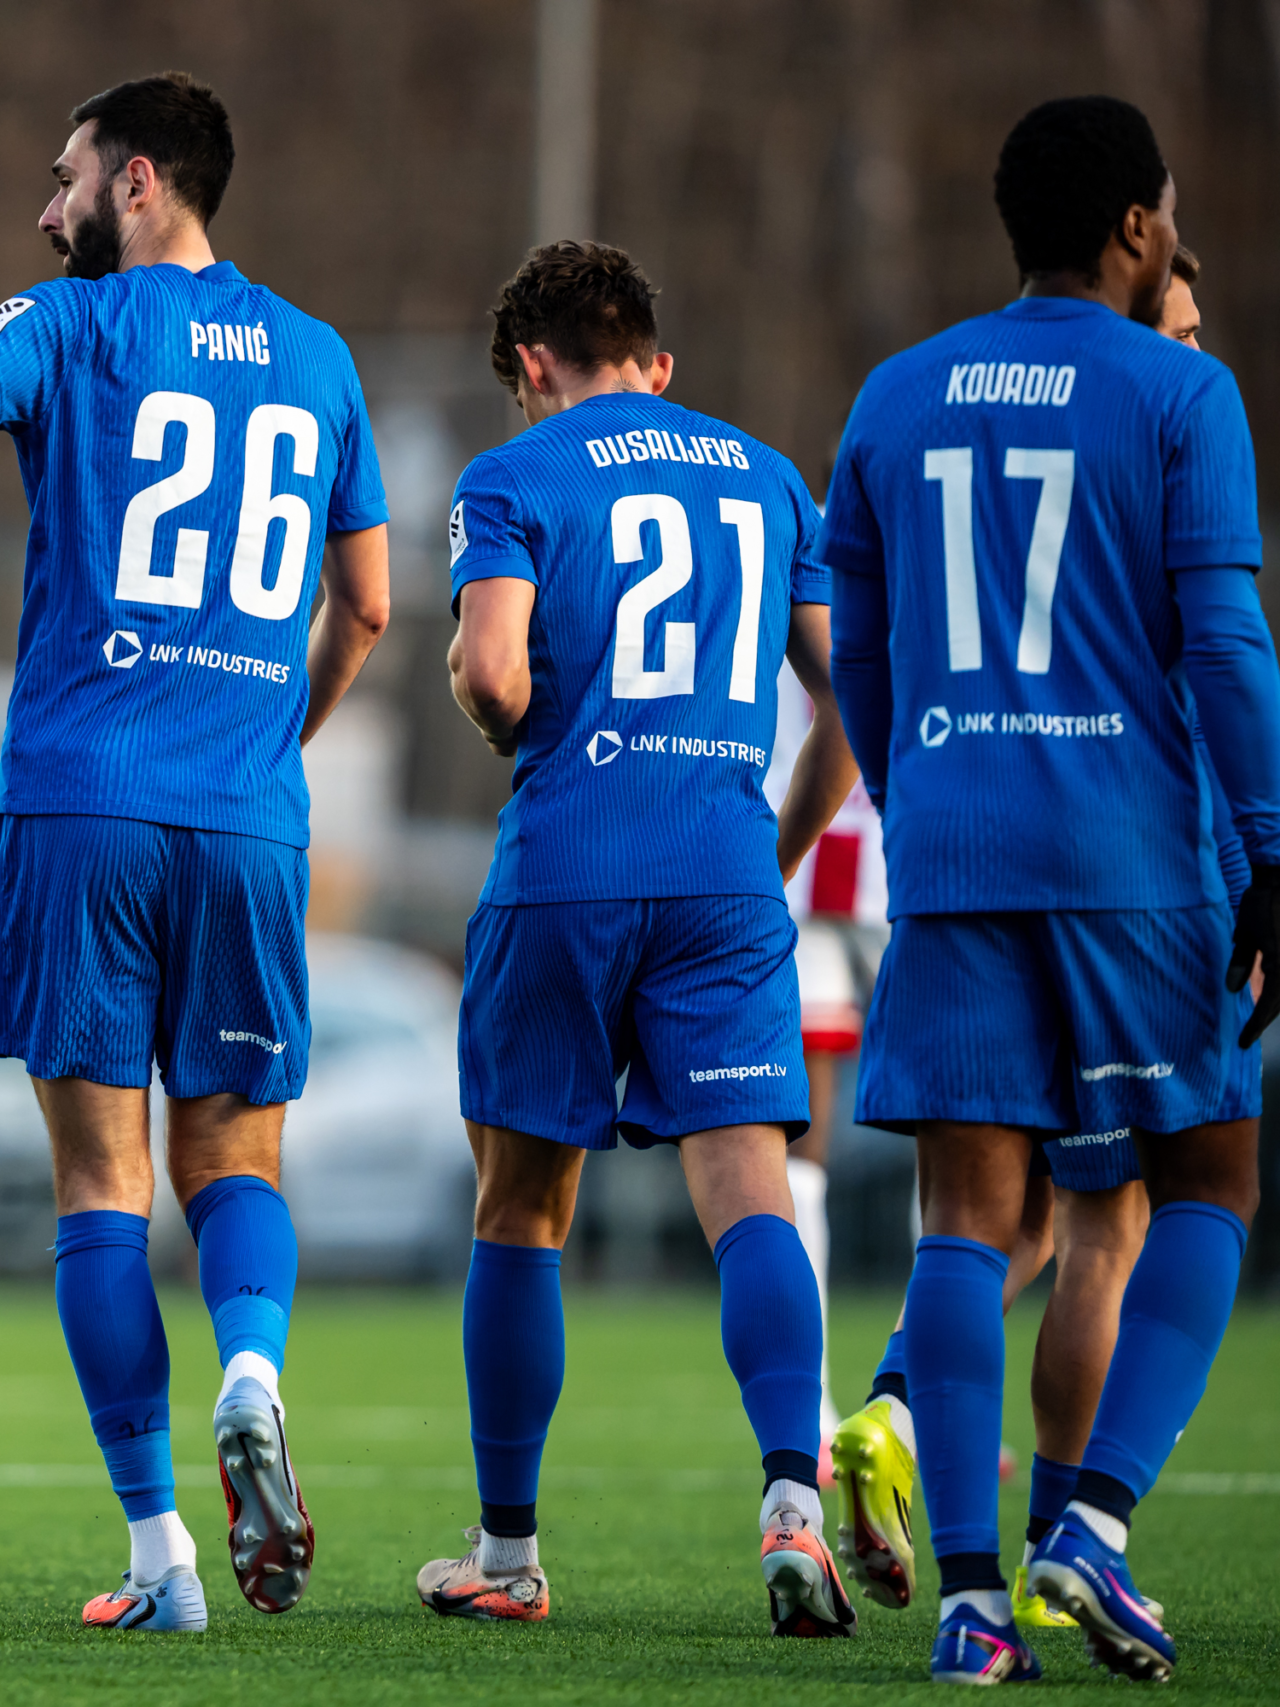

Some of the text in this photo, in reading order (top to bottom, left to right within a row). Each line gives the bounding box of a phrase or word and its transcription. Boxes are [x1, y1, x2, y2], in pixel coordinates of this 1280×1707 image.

[190, 320, 271, 366] PANIĆ
[946, 363, 1076, 406] KOUADIO
[585, 429, 750, 470] DUSALIJEVS
[115, 391, 319, 620] 26
[924, 447, 1075, 674] 17
[611, 493, 765, 703] 21
[149, 643, 290, 684] LNK INDUSTRIES
[957, 712, 1124, 737] LNK INDUSTRIES
[630, 735, 766, 768] LNK INDUSTRIES
[689, 1063, 787, 1082] teamsport.lv
[1081, 1063, 1174, 1081] eamsport.lv
